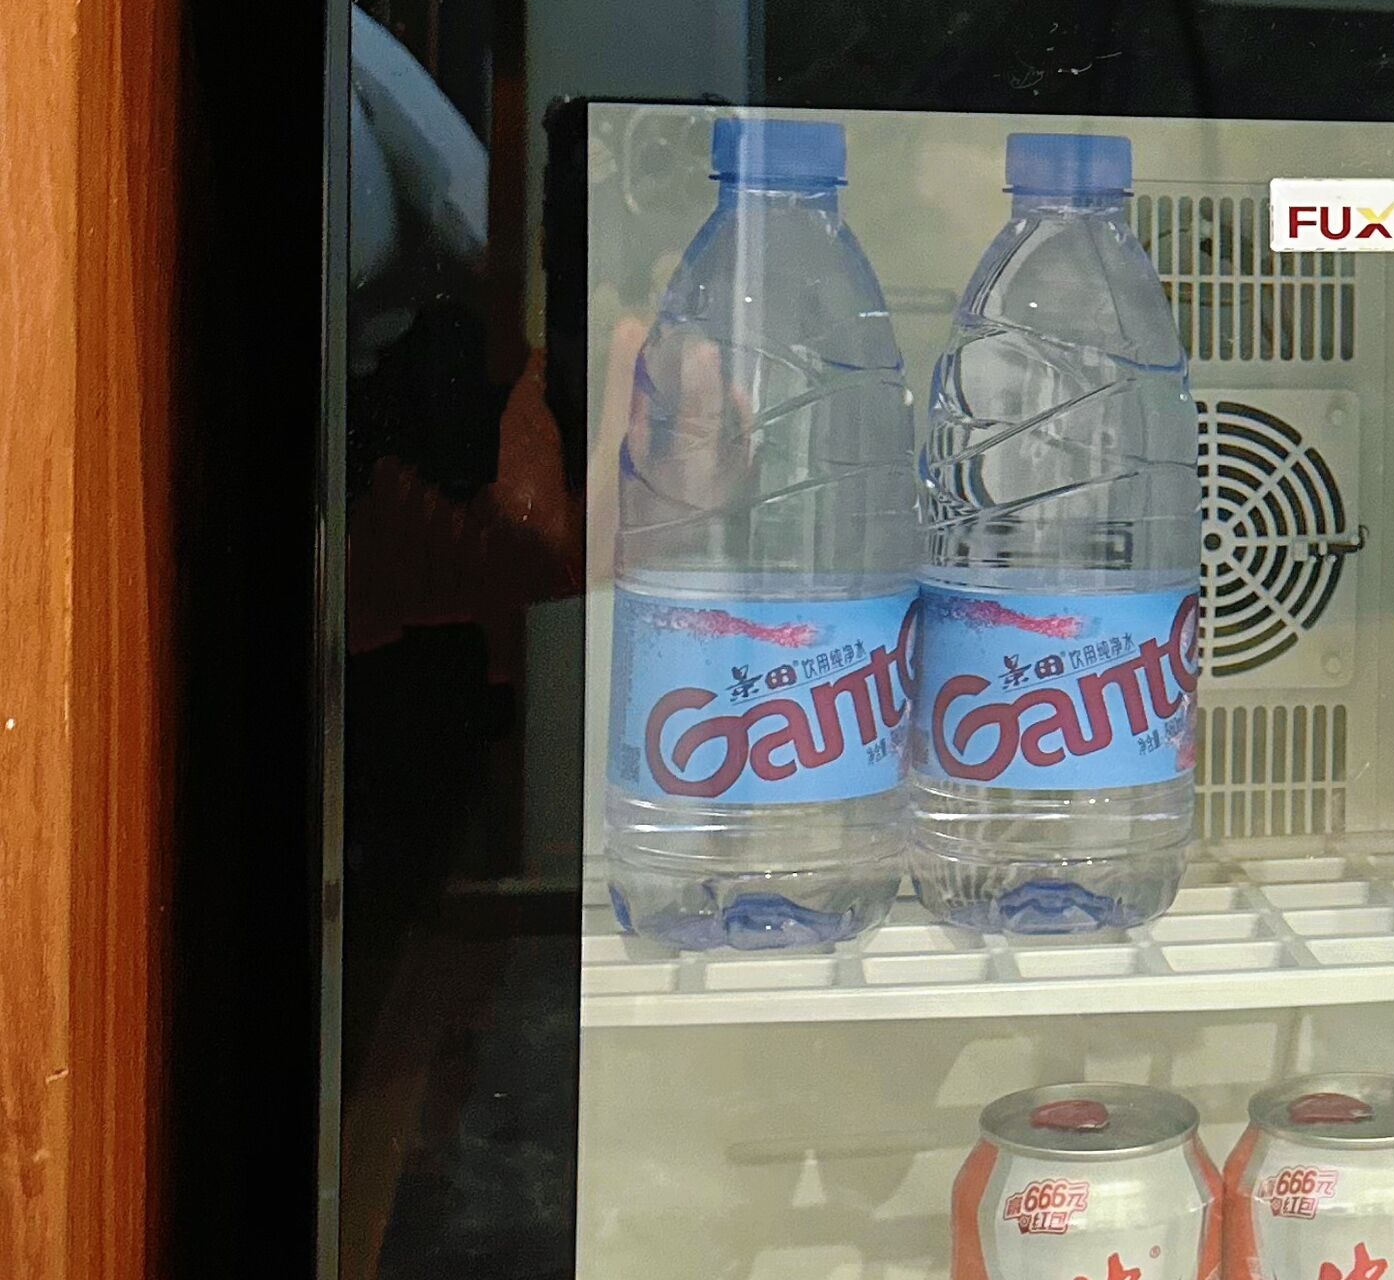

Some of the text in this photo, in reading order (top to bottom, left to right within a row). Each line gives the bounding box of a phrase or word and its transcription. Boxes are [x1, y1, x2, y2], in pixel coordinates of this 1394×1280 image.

[801, 638, 866, 679] 饮用纯净水
[1069, 632, 1134, 670] 饮用纯净水
